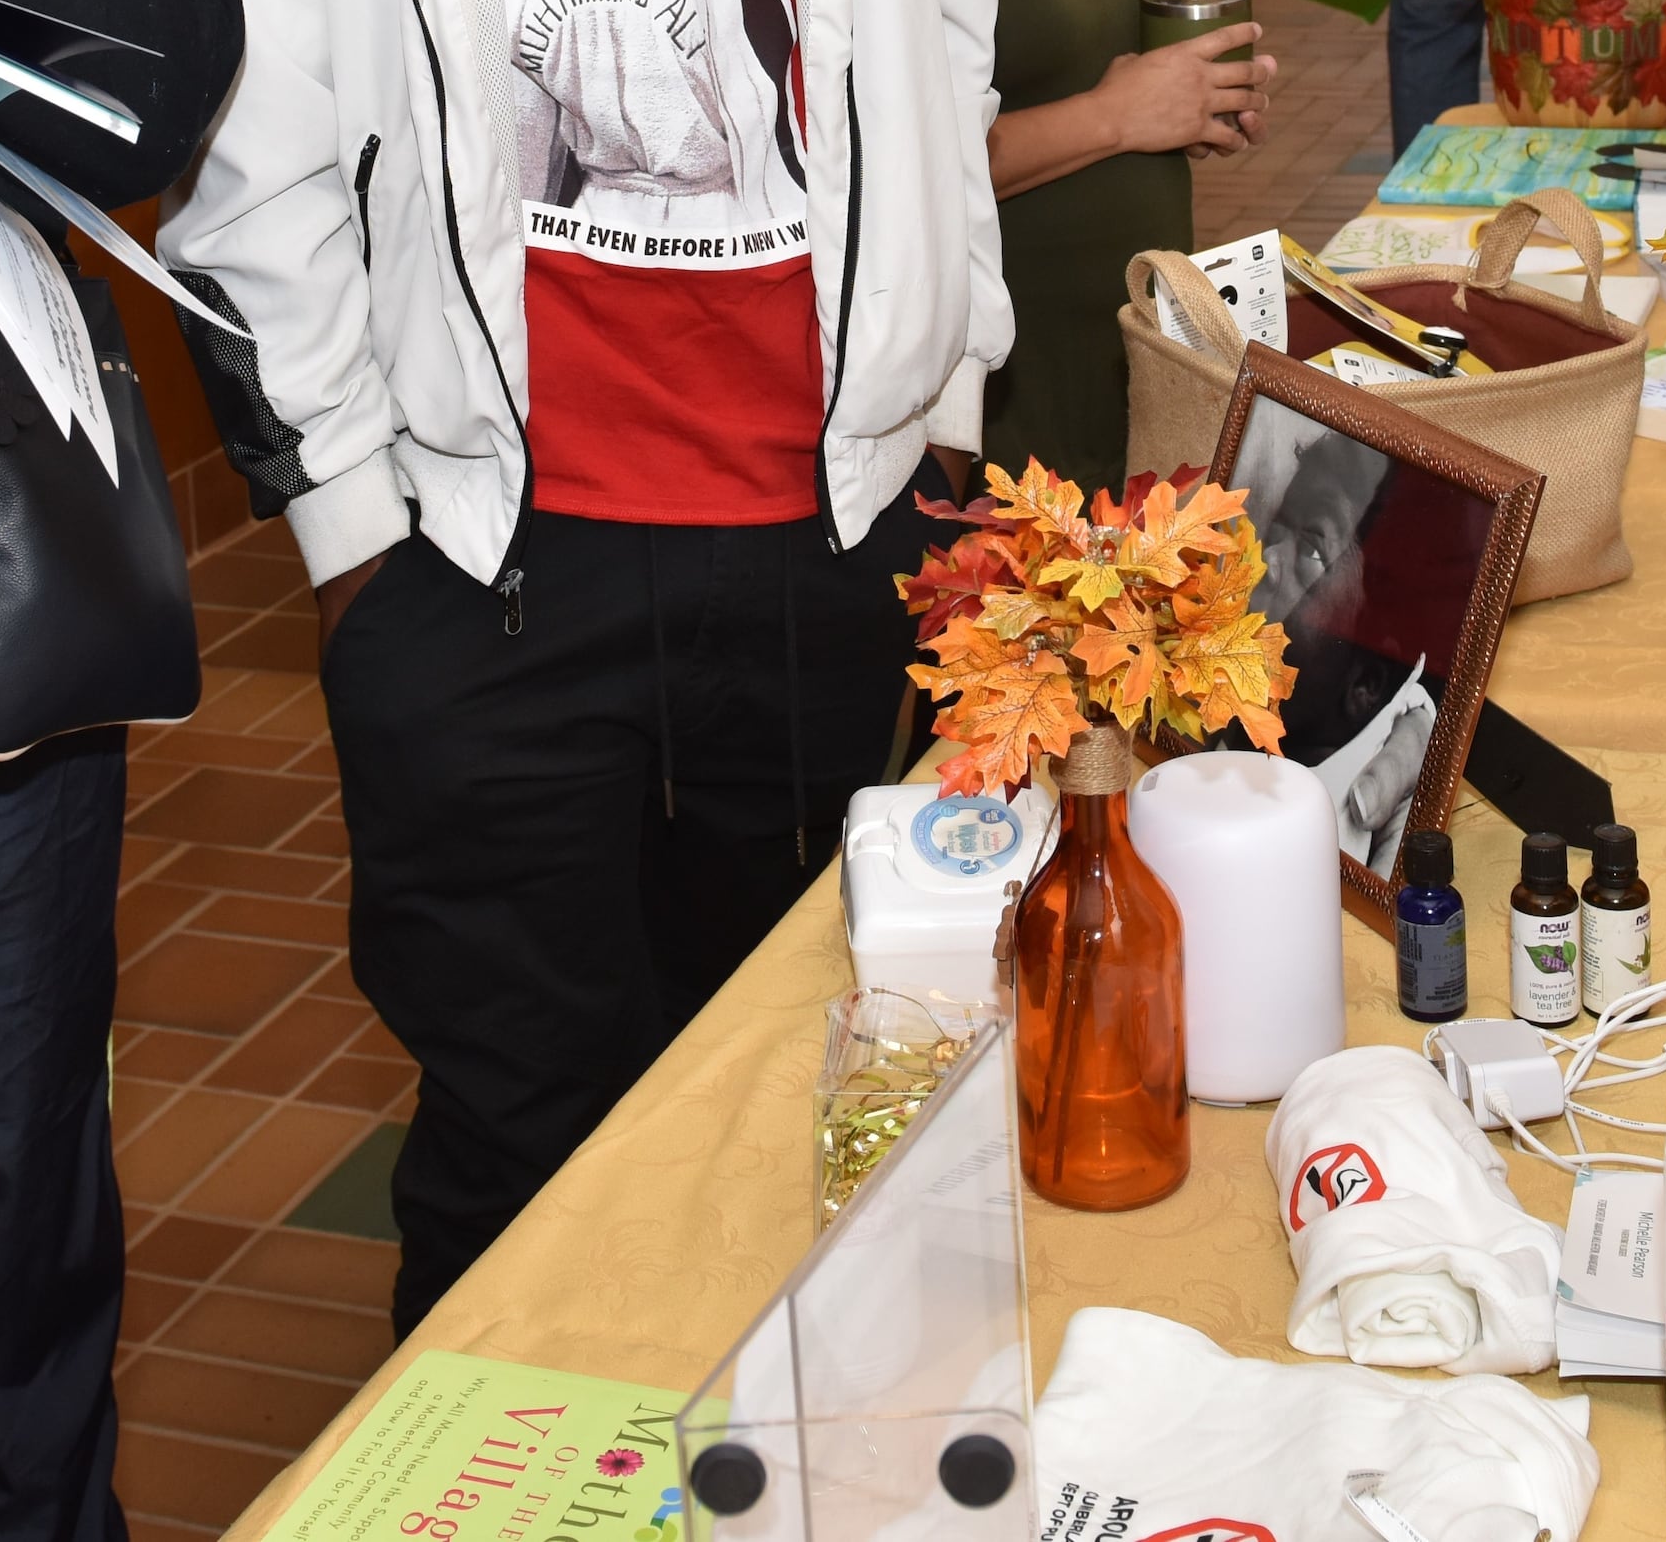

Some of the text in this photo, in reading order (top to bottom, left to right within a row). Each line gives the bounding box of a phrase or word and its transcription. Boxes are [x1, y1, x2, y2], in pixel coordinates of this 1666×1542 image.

[532, 212, 807, 258] THAT EVEN BEFORE I KNEW I W
[1529, 990, 1569, 1001] lavender
[1536, 999, 1572, 1010] tea tree
[1632, 1211, 1653, 1279] Michelle Pearson
[408, 1379, 429, 1399] and
[458, 1377, 489, 1399] Why
[388, 1401, 415, 1424] How
[446, 1401, 467, 1417] All
[376, 1427, 392, 1438] to
[381, 1404, 438, 1468] Motherhood
[421, 1419, 454, 1450] Moms
[355, 1441, 383, 1466] Find
[396, 1454, 429, 1485] Need
[332, 1478, 354, 1494] for
[380, 1486, 403, 1504] the
[497, 1445, 580, 1542] OF THE
[1057, 1482, 1080, 1508] DEPT
[328, 1471, 387, 1530] Community
[293, 1498, 338, 1542] Yourself
[1050, 1508, 1067, 1527] OF
